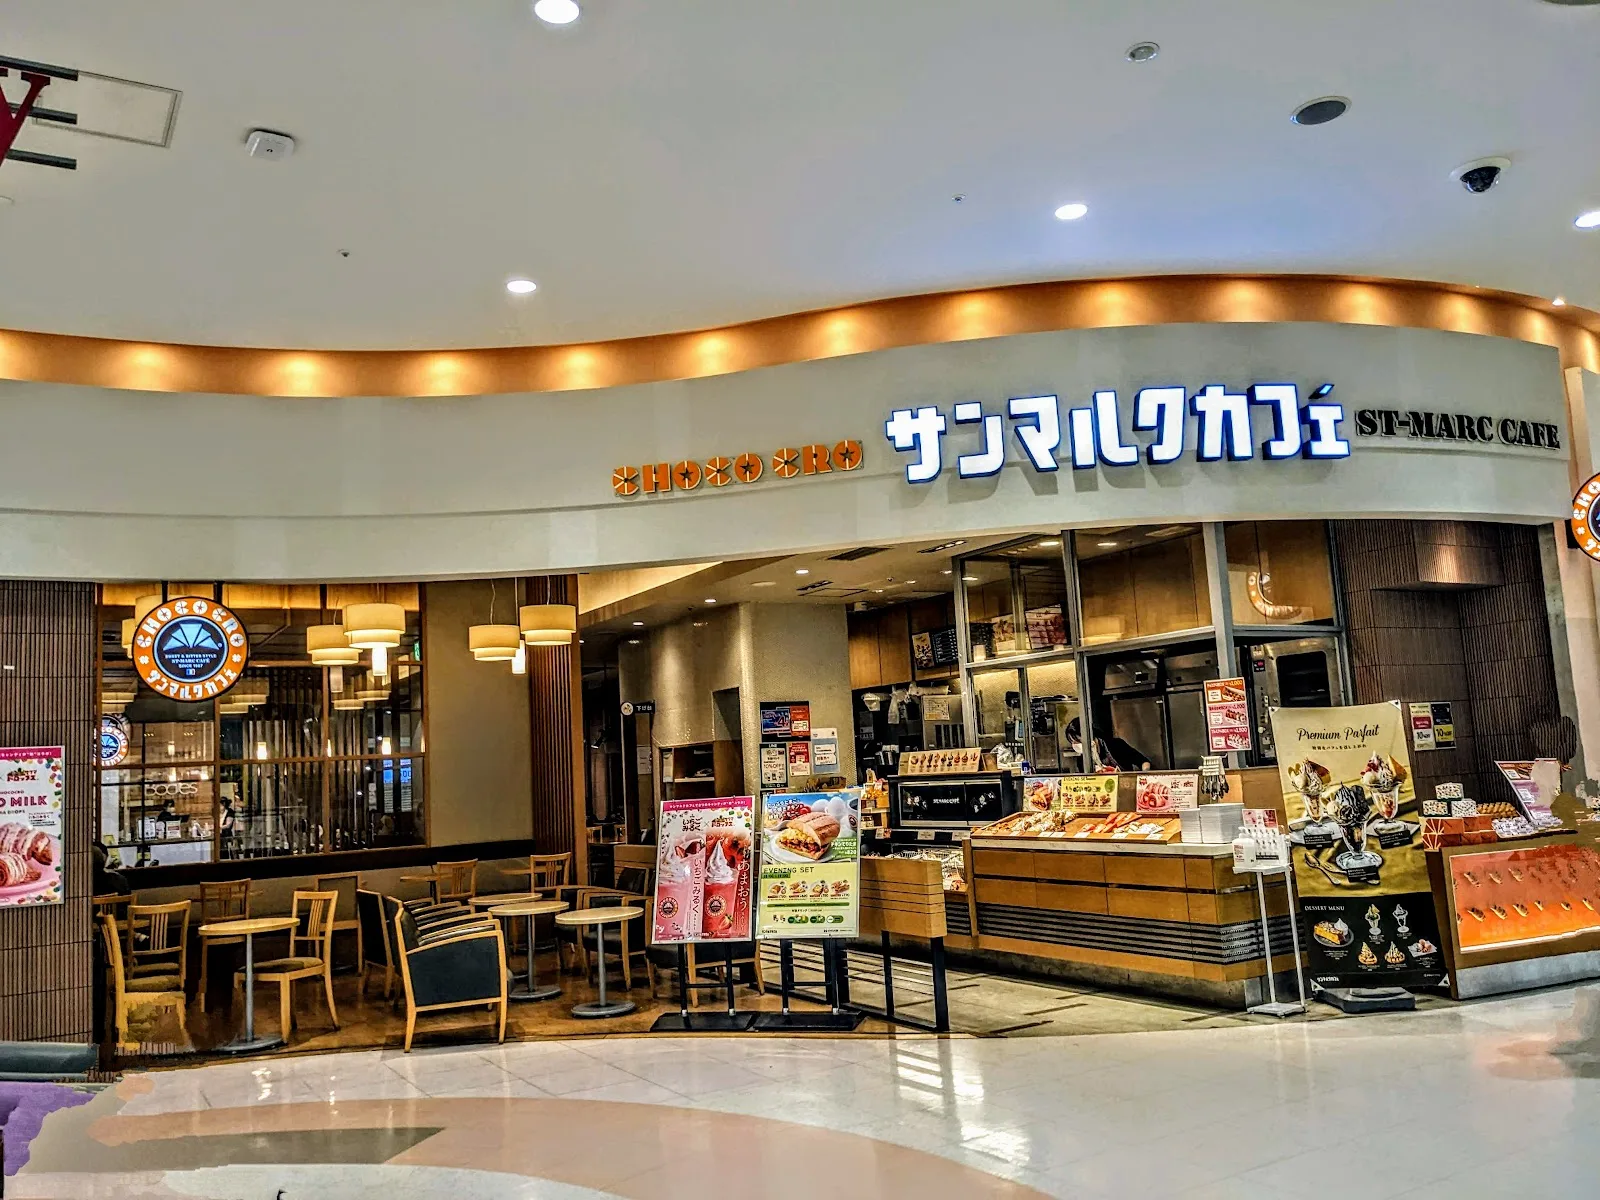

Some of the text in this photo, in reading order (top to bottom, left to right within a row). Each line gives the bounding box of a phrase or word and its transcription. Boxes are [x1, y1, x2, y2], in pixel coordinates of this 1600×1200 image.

[1355, 408, 1560, 450] ST-MARC CAFE
[611, 438, 864, 496] CHOCO CRO
[1297, 724, 1380, 743] Premium Parfait
[10, 795, 48, 807] MILK
[799, 866, 815, 874] SET
